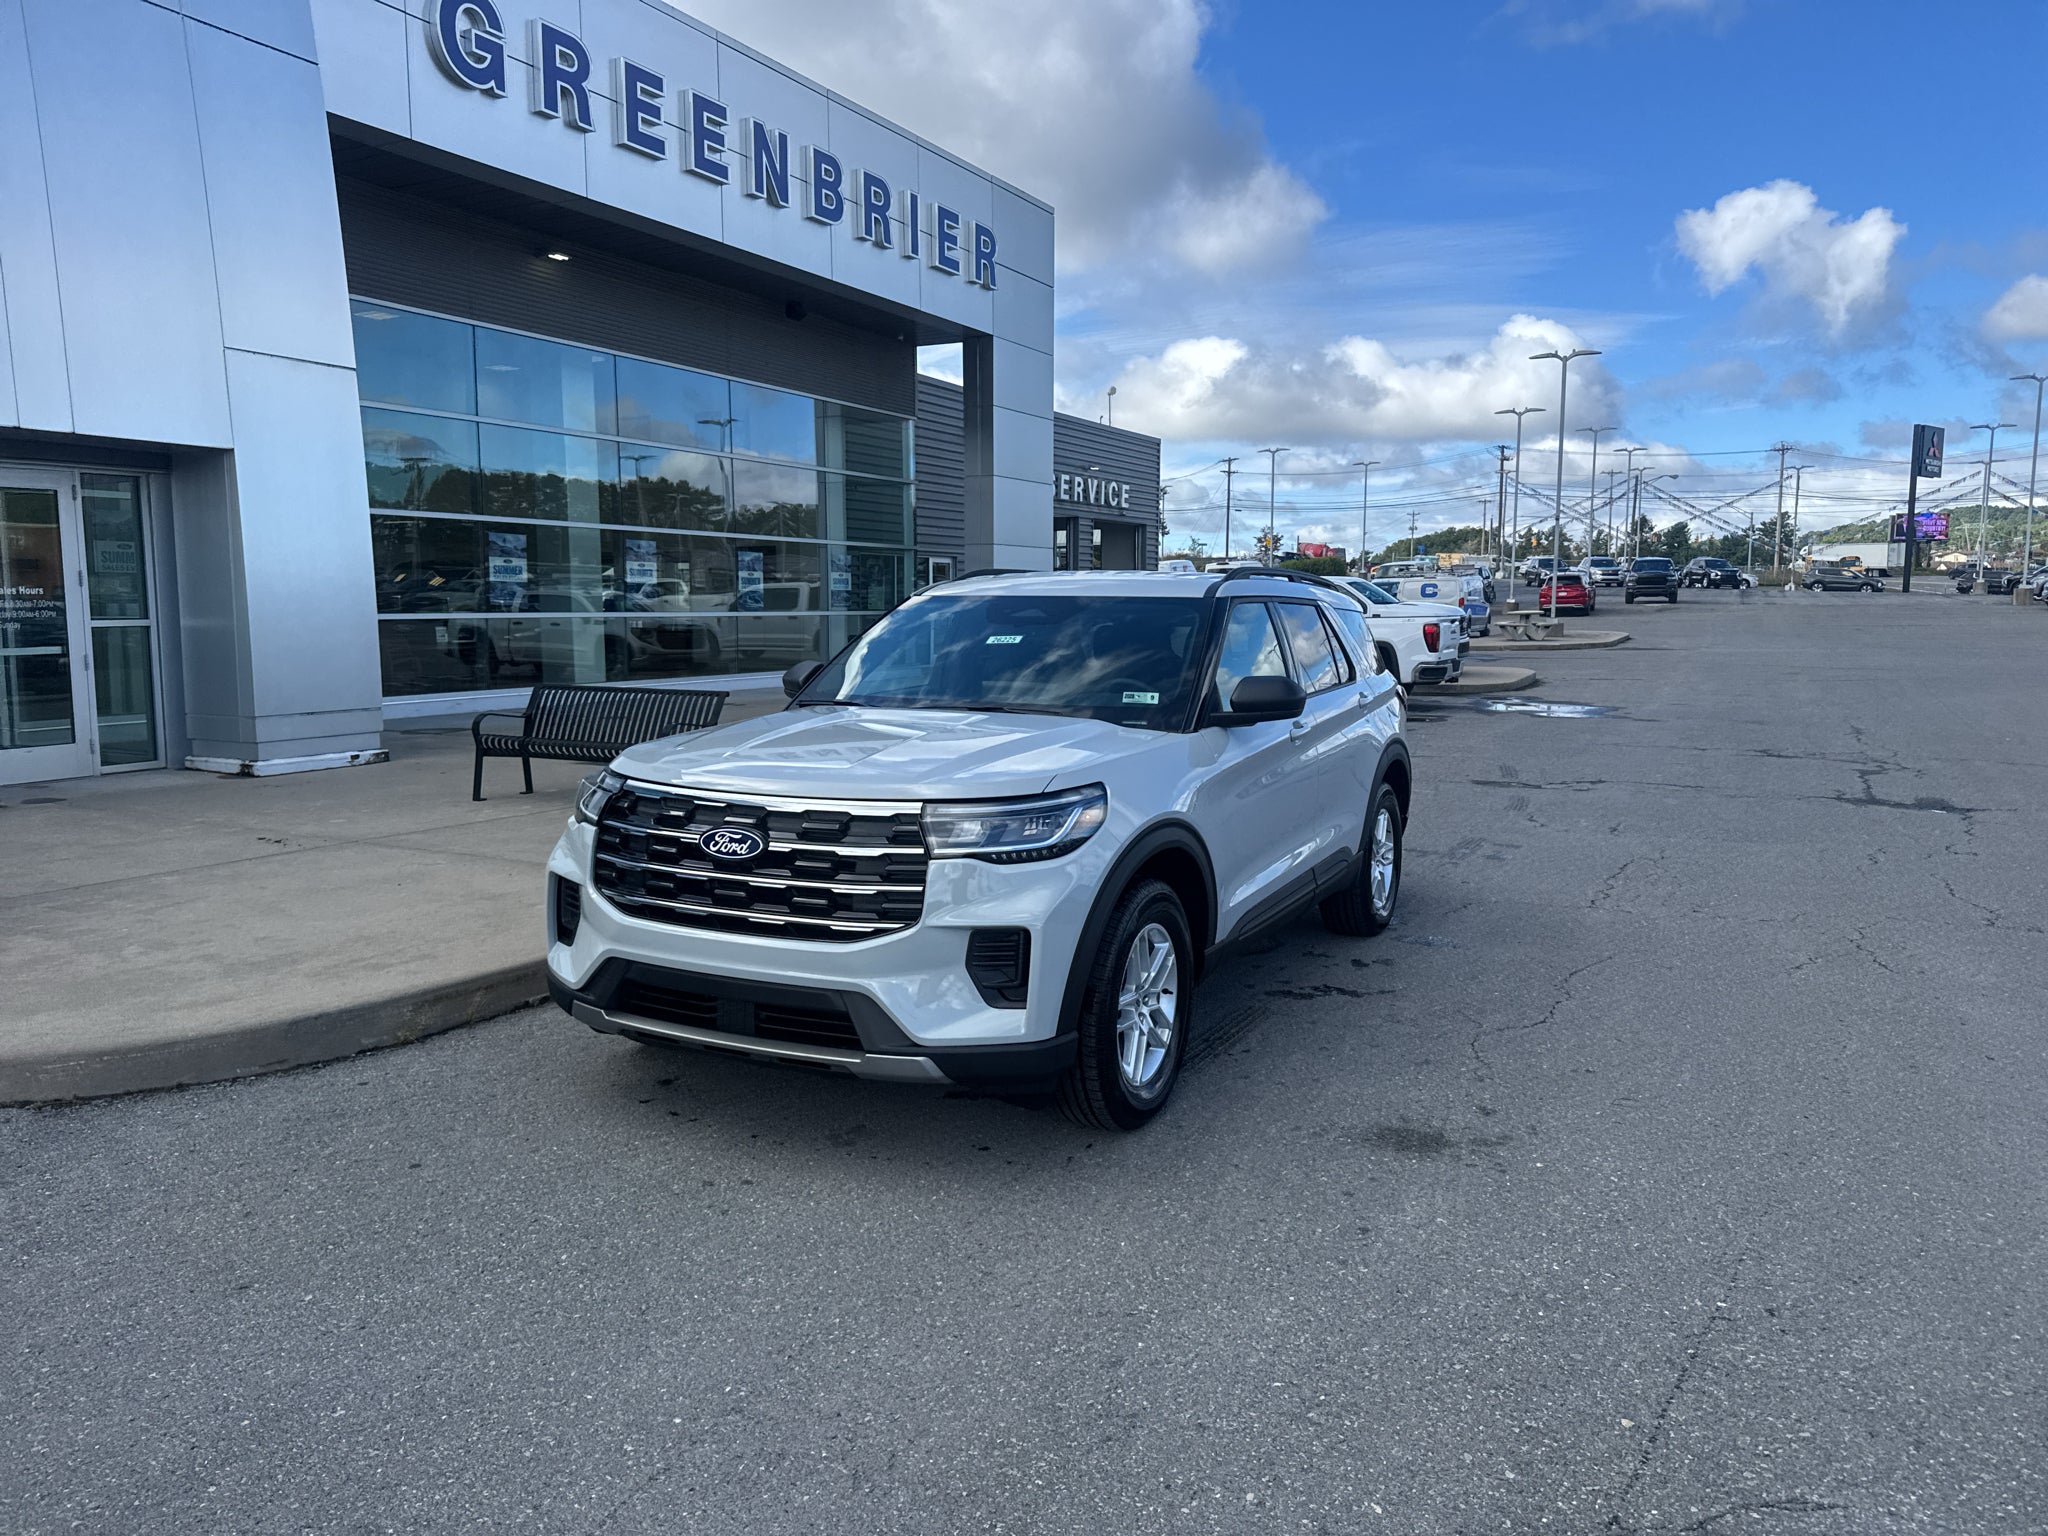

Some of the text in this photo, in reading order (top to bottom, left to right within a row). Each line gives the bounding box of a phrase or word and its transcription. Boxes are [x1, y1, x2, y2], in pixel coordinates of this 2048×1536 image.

[428, 0, 998, 291] GREENBRIER
[493, 564, 523, 576] SUMMER
[19, 586, 44, 595] Hours
[710, 832, 752, 854] Ford
